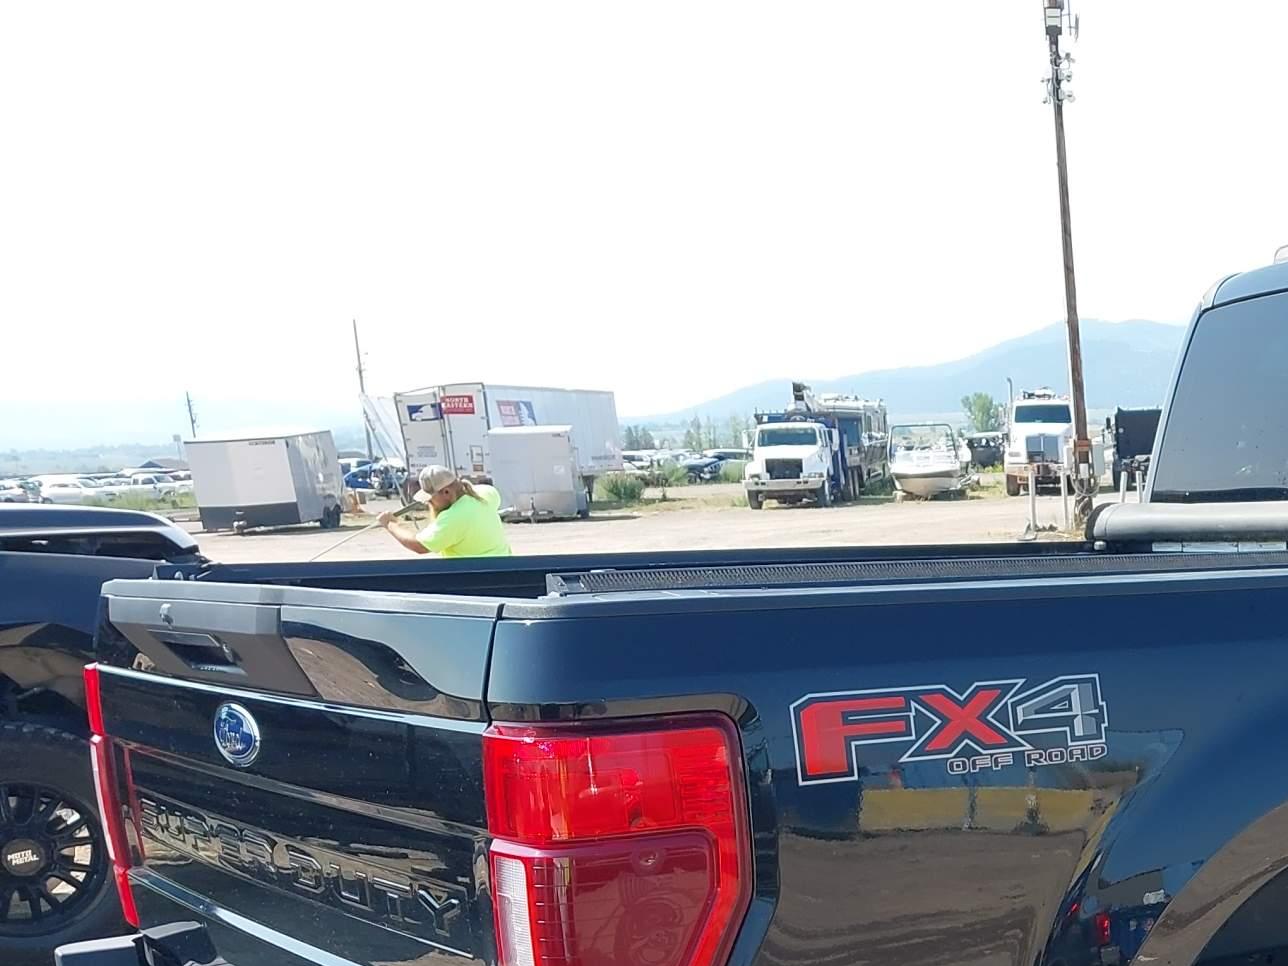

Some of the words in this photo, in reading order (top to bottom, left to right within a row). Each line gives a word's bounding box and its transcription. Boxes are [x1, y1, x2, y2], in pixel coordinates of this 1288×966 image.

[789, 673, 1108, 786] FX4
[947, 752, 1013, 775] OFF
[1025, 743, 1107, 767] ROAD
[141, 798, 277, 872] SUPER
[286, 844, 460, 937] DUTY
